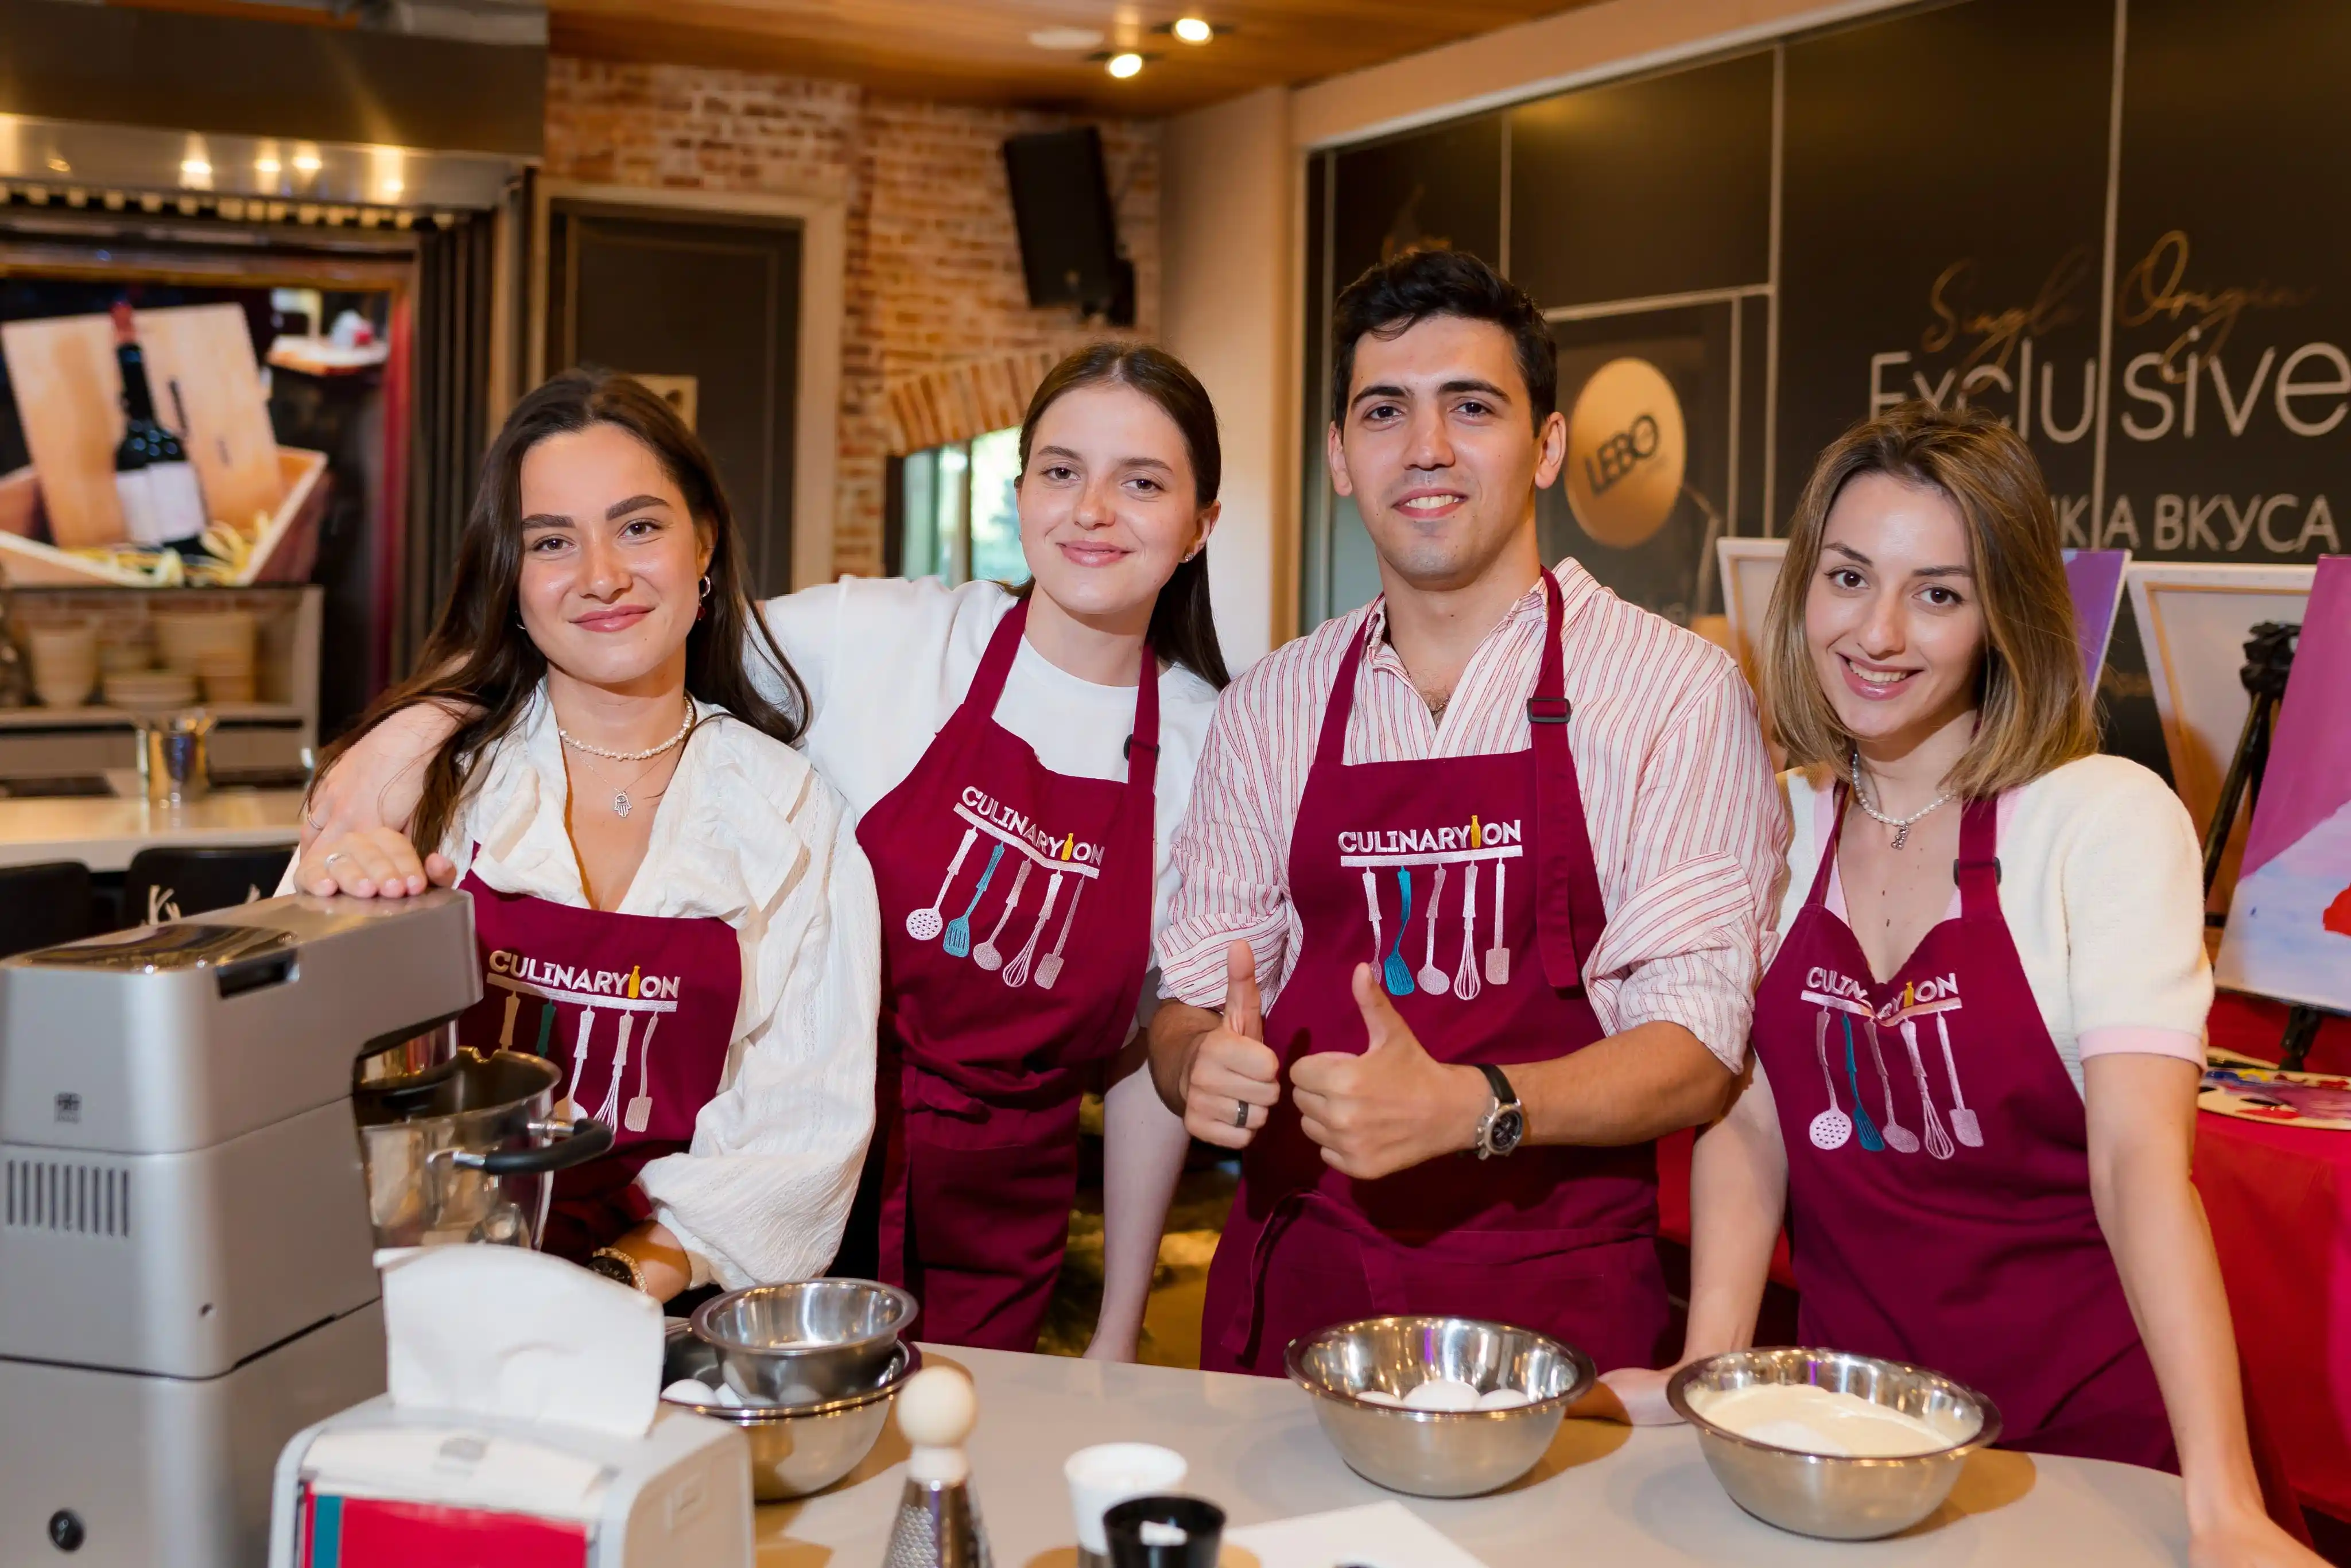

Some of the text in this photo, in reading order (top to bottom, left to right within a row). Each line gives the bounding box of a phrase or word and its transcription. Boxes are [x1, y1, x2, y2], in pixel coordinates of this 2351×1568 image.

[1870, 339, 2351, 444] Exclusive
[1584, 414, 1658, 497] LEBO
[2051, 493, 2341, 554] КА ВКУСА
